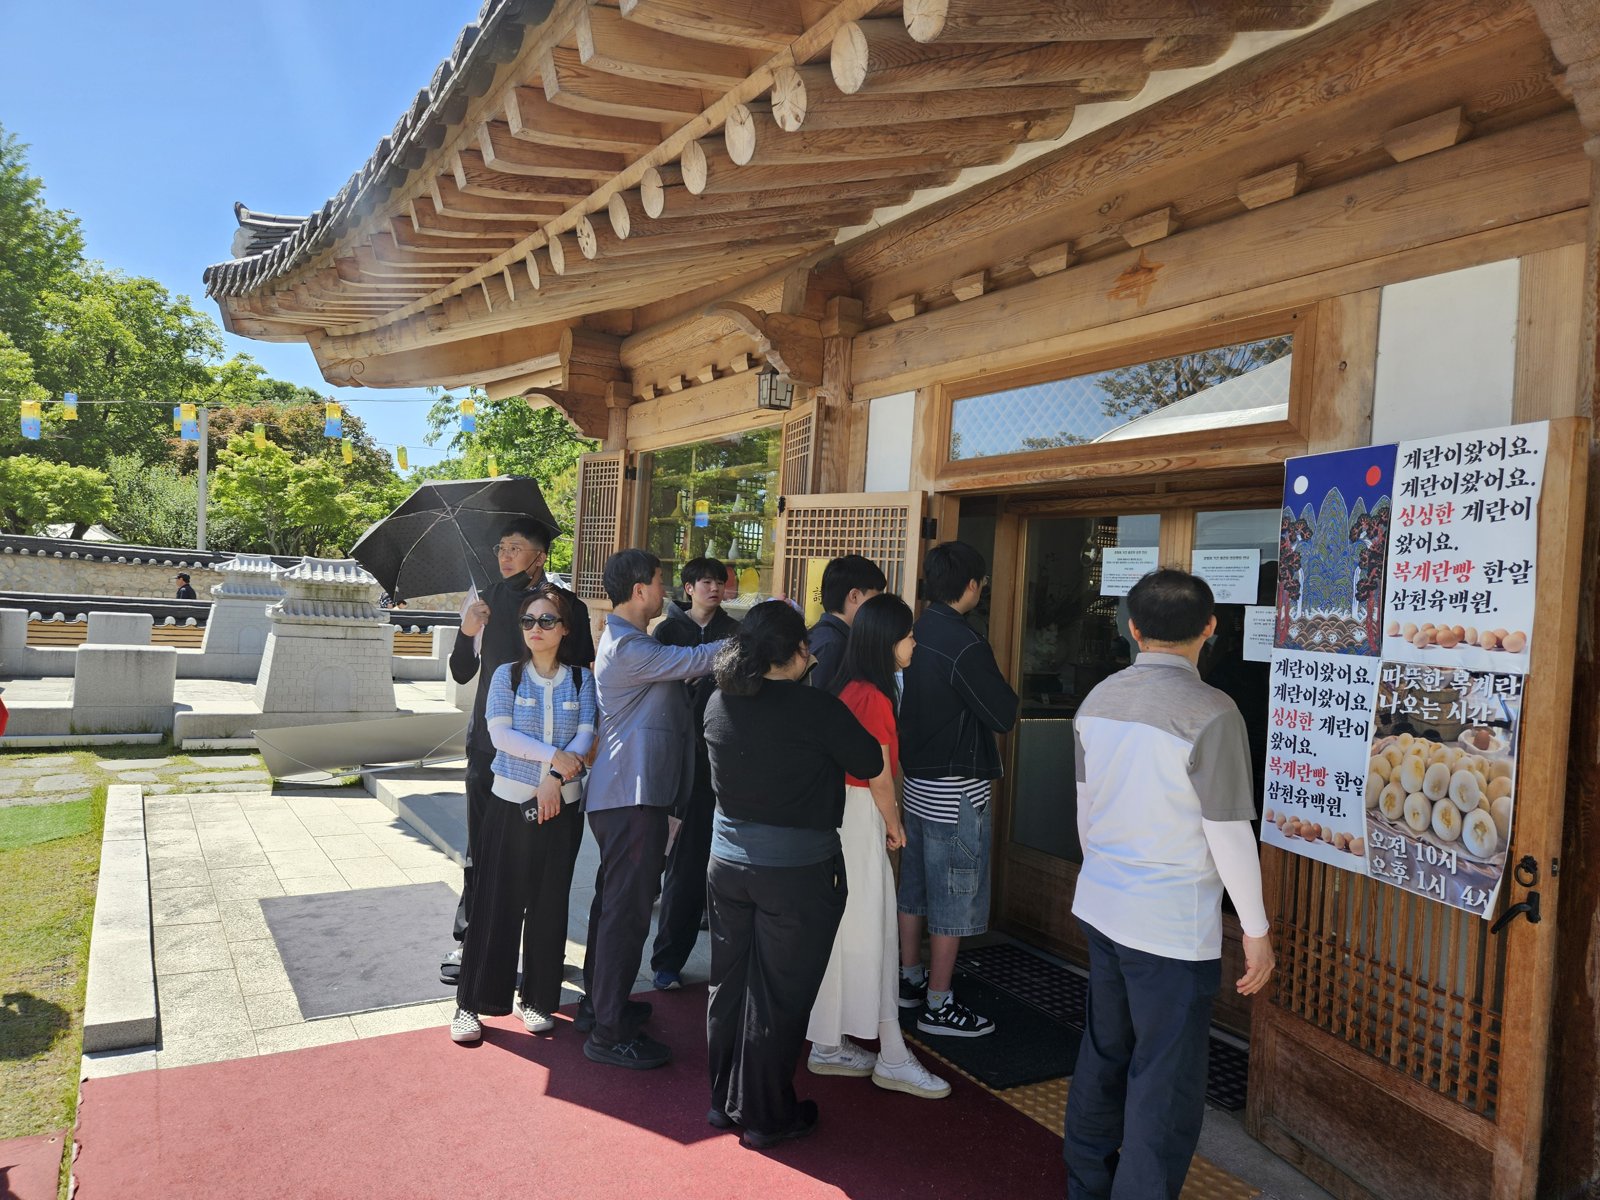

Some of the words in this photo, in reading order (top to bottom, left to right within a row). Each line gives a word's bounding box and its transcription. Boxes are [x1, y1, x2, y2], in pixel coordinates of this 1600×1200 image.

[1397, 501, 1455, 527] 싱싱한
[1461, 496, 1532, 523] 계란이
[1395, 531, 1459, 556] 왔어요.
[1393, 559, 1476, 584] 복계란빵
[1483, 559, 1533, 585] 한알
[1390, 588, 1498, 615] 삼천육백원.
[1382, 664, 1445, 692] 따뜻한
[1449, 669, 1521, 701] 복계란
[1272, 706, 1314, 732] 싱싱한
[1319, 715, 1369, 742] 계란이
[1379, 690, 1441, 720] 나오는
[1446, 699, 1492, 727] 시간
[1270, 731, 1317, 757] 왔어요.
[1269, 756, 1329, 787] 복계란빵
[1267, 780, 1347, 818] 삼천육백원.
[1369, 828, 1408, 859] 오전
[1414, 842, 1457, 875] 10시
[1371, 854, 1410, 885] 오후
[1417, 870, 1446, 900] 1시
